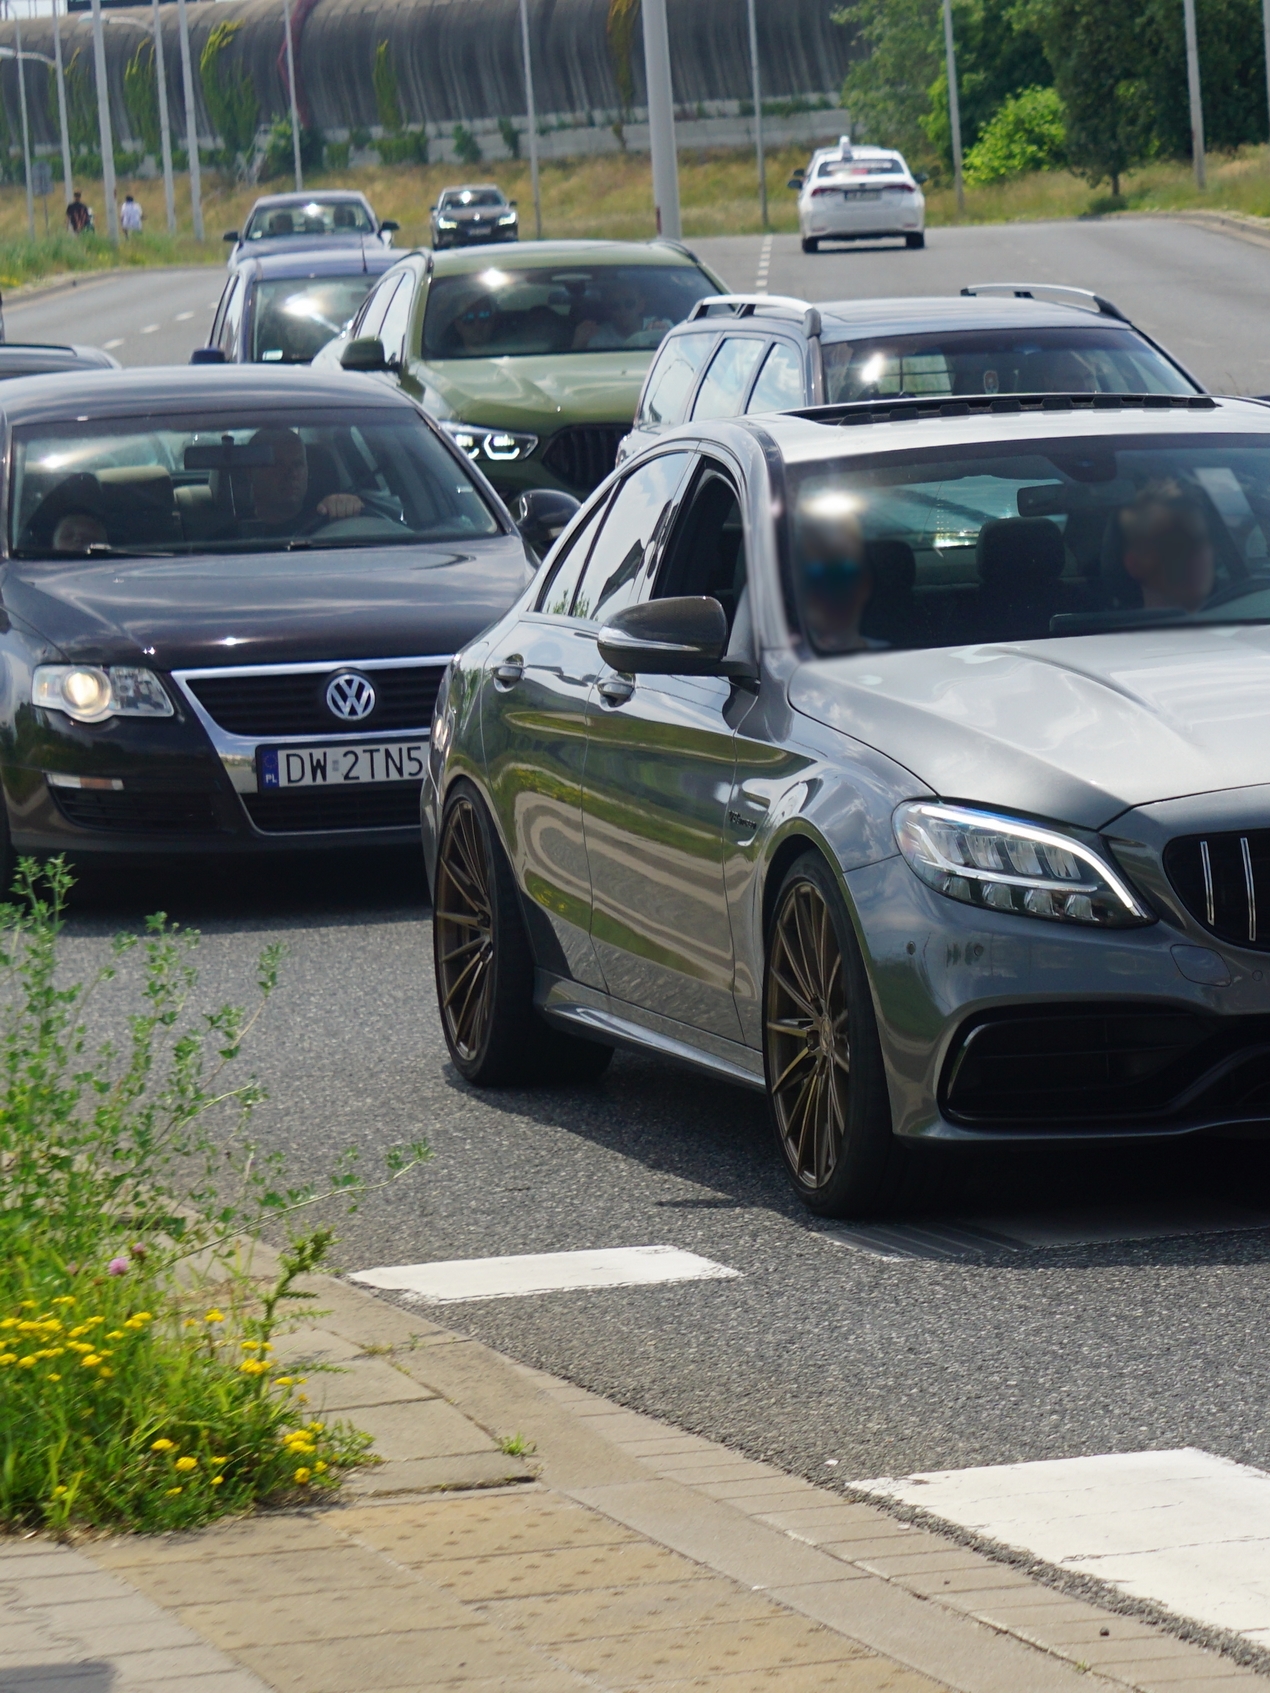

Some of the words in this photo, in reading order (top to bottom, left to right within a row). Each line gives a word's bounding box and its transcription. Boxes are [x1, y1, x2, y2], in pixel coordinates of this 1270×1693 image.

[285, 751, 328, 785] DW
[342, 746, 424, 782] 2TN5
[265, 773, 278, 784] PL
